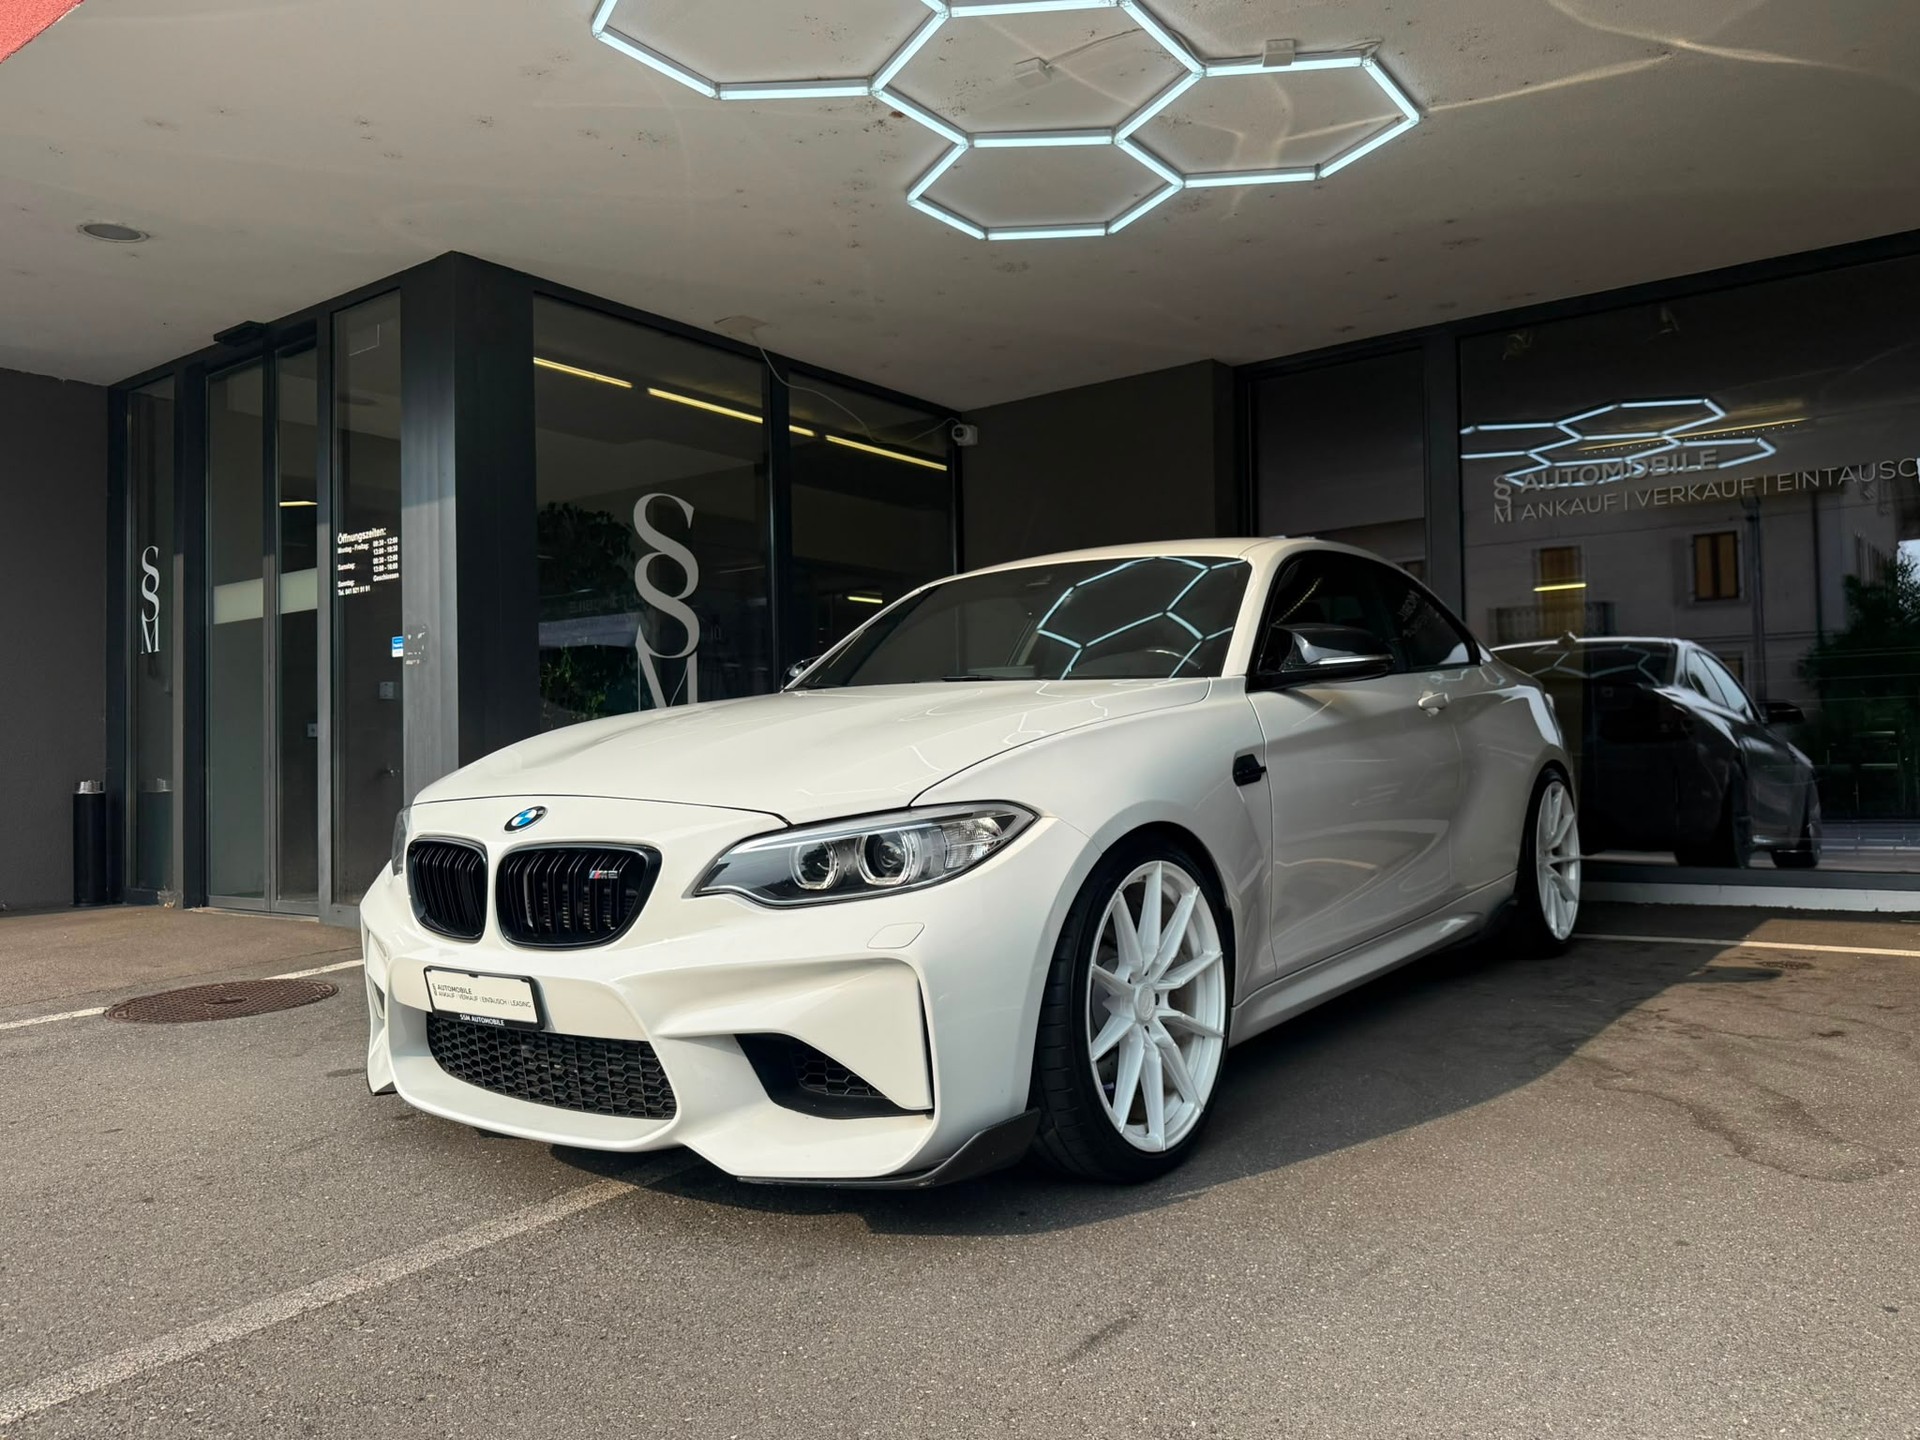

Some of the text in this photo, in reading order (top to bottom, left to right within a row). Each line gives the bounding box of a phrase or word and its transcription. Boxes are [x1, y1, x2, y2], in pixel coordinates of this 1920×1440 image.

[1520, 449, 1717, 493] AUTOMOBILE
[1521, 493, 1618, 520] ANKAUF
[1635, 477, 1756, 507] VERKAUF
[437, 984, 472, 994] AUTOMOBILE
[511, 999, 532, 1008] LEASING
[471, 1016, 505, 1026] AUTOMOBILE
